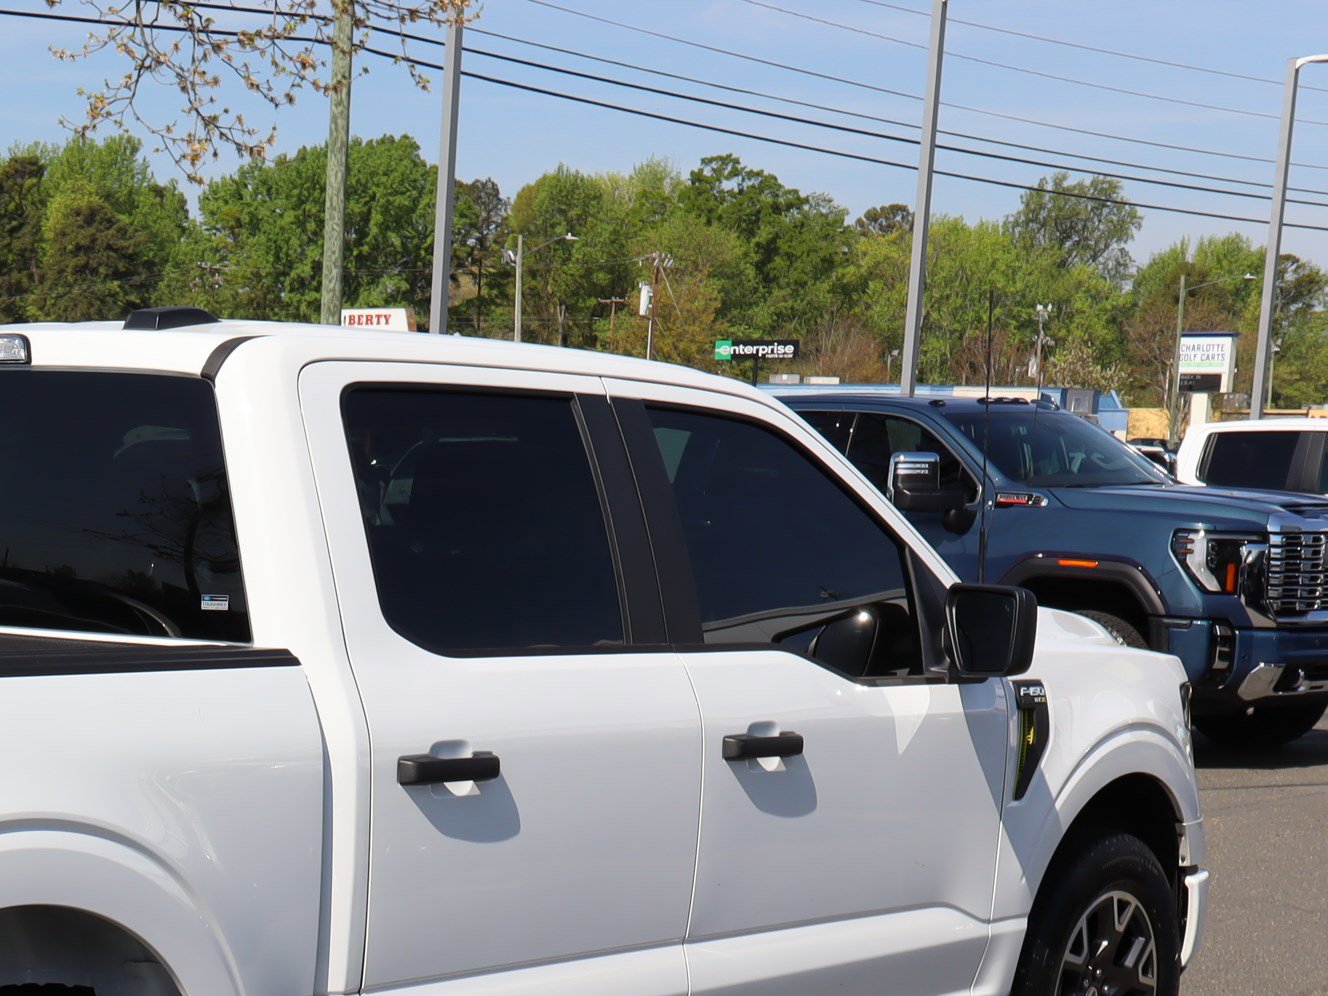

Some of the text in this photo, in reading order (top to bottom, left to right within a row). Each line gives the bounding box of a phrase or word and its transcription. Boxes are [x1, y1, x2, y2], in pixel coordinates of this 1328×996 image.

[719, 342, 794, 357] enterprise
[1180, 343, 1225, 352] CHARLOTTE
[1179, 353, 1226, 362] GOLF CARTS
